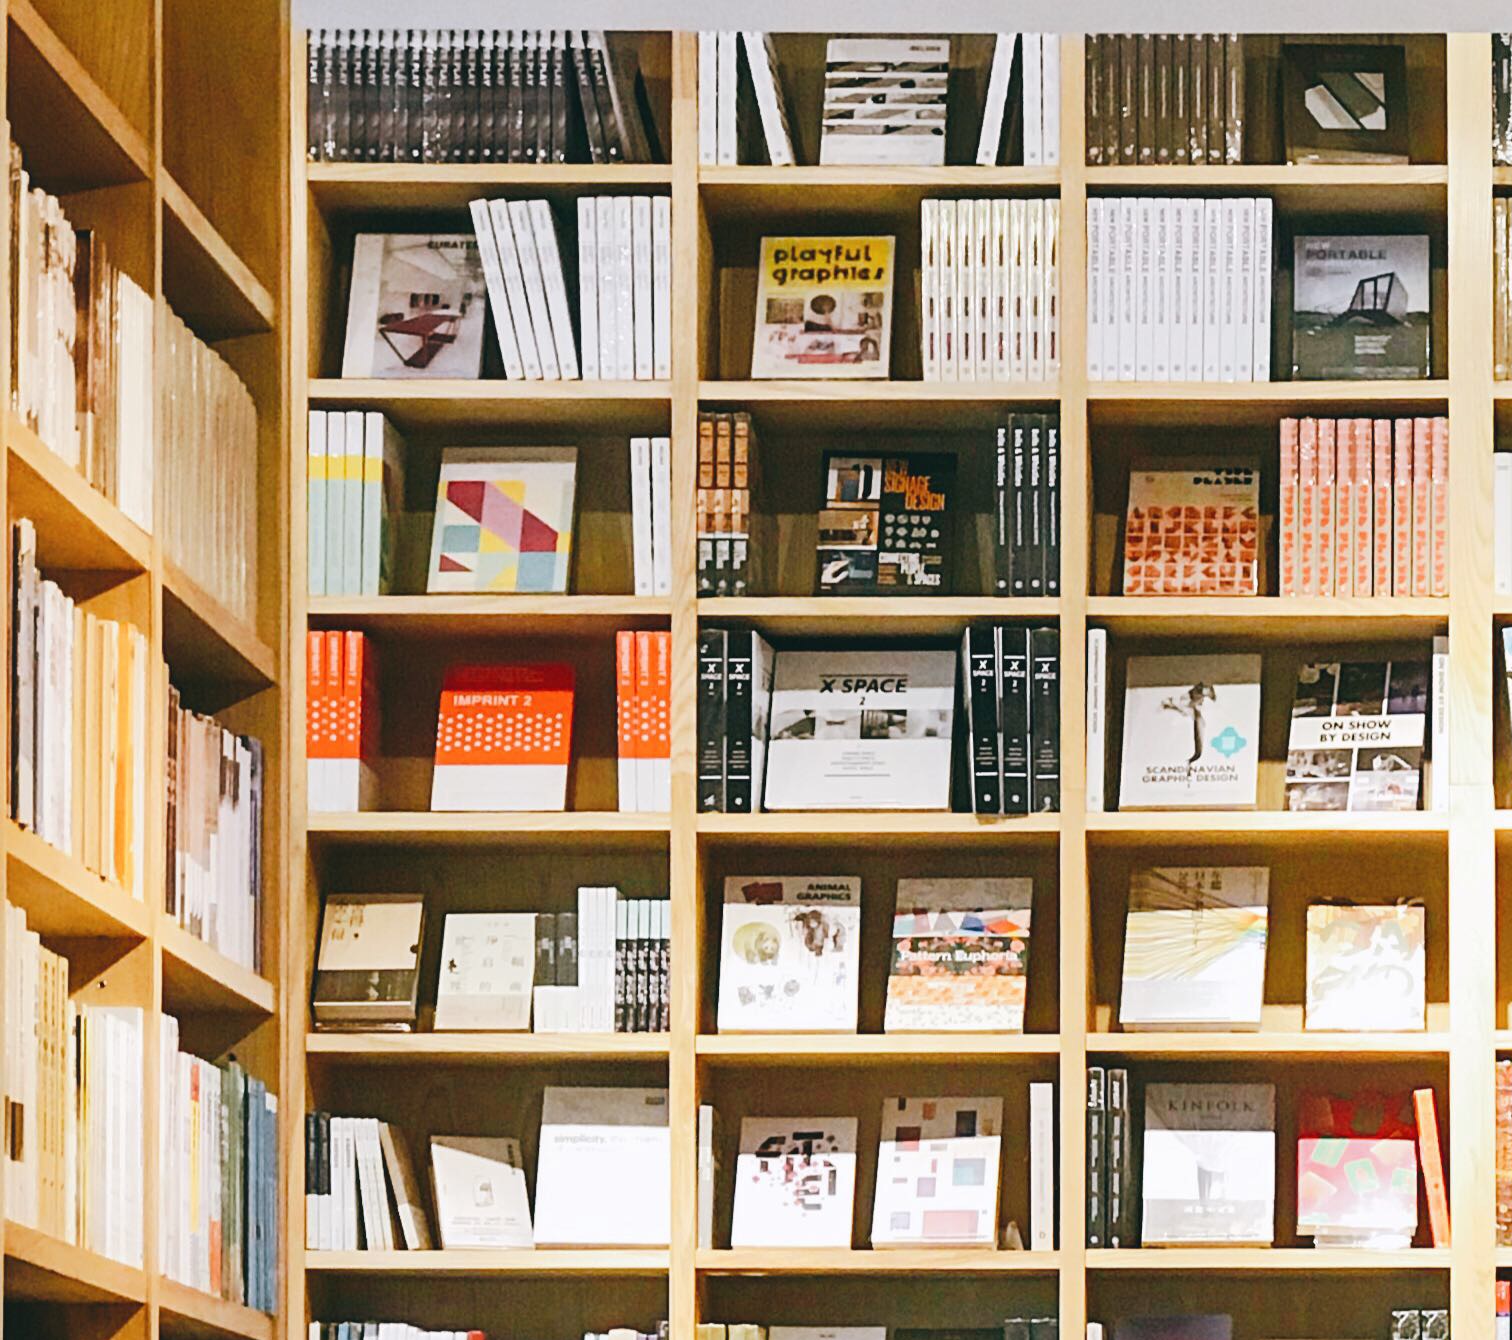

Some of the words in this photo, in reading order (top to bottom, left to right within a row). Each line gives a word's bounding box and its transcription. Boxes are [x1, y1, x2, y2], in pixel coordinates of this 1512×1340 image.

[773, 244, 872, 266] playful
[1305, 249, 1387, 261] PORTABLE
[772, 265, 885, 285] graphics
[904, 492, 945, 511] DESIGN
[819, 679, 834, 693] X
[841, 678, 908, 693] SPACE
[453, 695, 517, 707] IMPRINT
[523, 695, 532, 707] 2
[860, 696, 866, 706] 2
[1321, 721, 1344, 731] ON
[1348, 719, 1391, 730] SHOW
[1319, 732, 1335, 742] BY
[1342, 731, 1391, 742] DESIGN
[1146, 764, 1236, 774] SCANDINAVIAN
[1142, 774, 1192, 783] GRAPHIC
[1196, 773, 1238, 783] DESIGN
[807, 884, 851, 892] ANIMAL
[797, 892, 852, 901] GRAPHICS
[899, 949, 952, 962] Pattern
[954, 949, 1019, 964] Euphoria
[1167, 1099, 1256, 1112] KINFOLK
